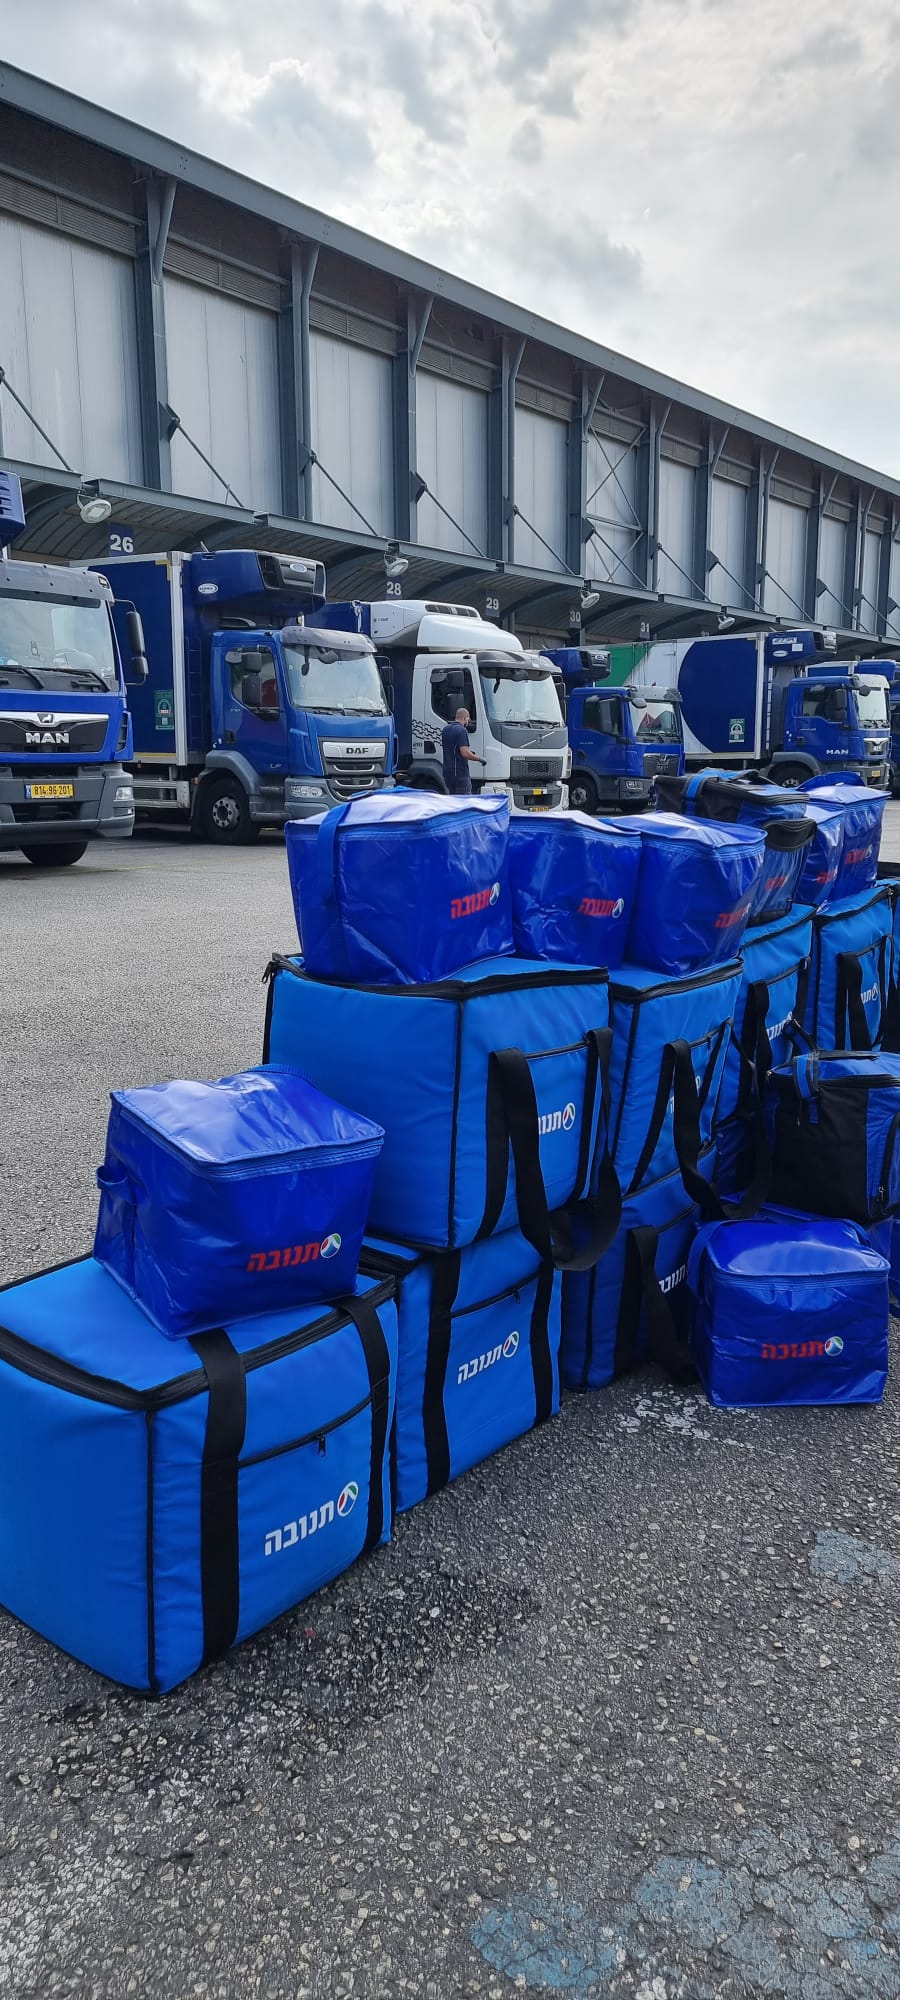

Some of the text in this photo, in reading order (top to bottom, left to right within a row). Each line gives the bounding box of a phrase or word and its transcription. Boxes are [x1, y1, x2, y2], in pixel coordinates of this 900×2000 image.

[110, 534, 134, 553] 26
[386, 581, 402, 596] 28
[486, 597, 499, 610] 29
[570, 611, 581, 622] 30
[640, 622, 650, 633] 31
[25, 732, 69, 744] MAN
[451, 889, 491, 919] תנובה
[538, 1111, 562, 1136] תנו
[247, 1242, 321, 1272] תנובה
[762, 1341, 824, 1360] תנובה
[457, 1344, 502, 1385] תנובה
[265, 1500, 335, 1556] תנובה
